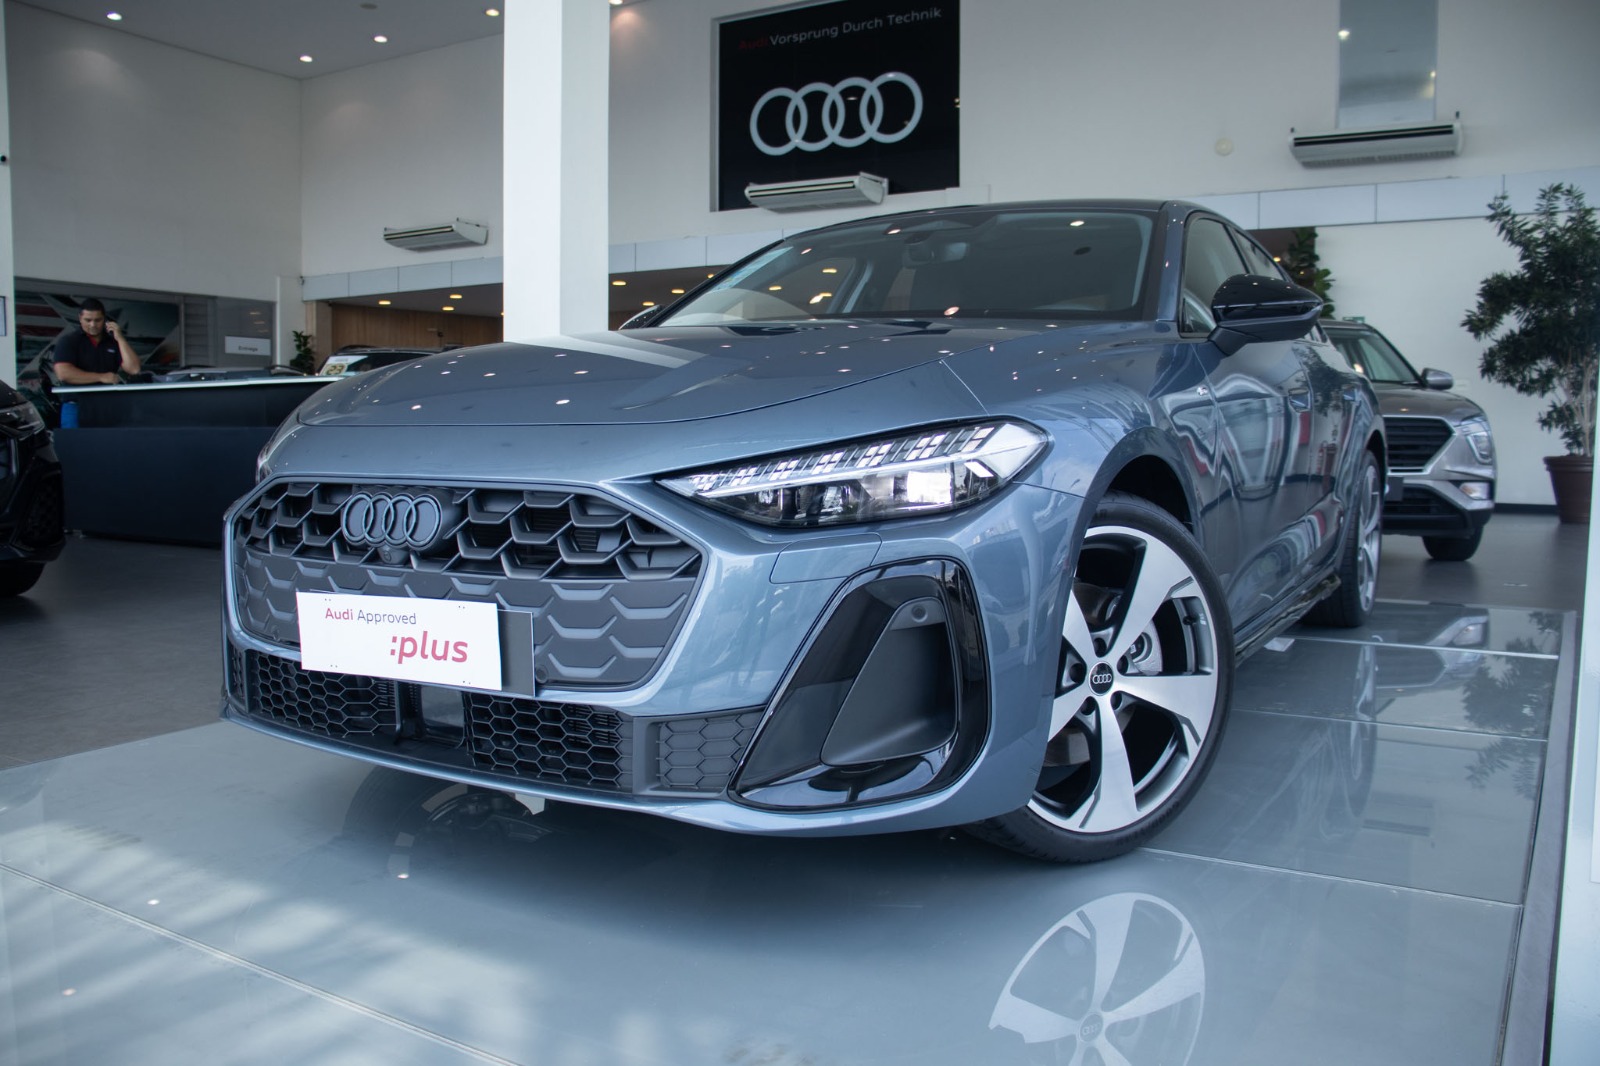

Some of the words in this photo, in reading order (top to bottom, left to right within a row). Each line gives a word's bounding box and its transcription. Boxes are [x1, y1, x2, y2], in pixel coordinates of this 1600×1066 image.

[770, 26, 839, 46] Vorsprung
[843, 17, 883, 34] Durch
[887, 7, 942, 26] Technik
[325, 608, 354, 621] Audi
[357, 609, 417, 625] Approved
